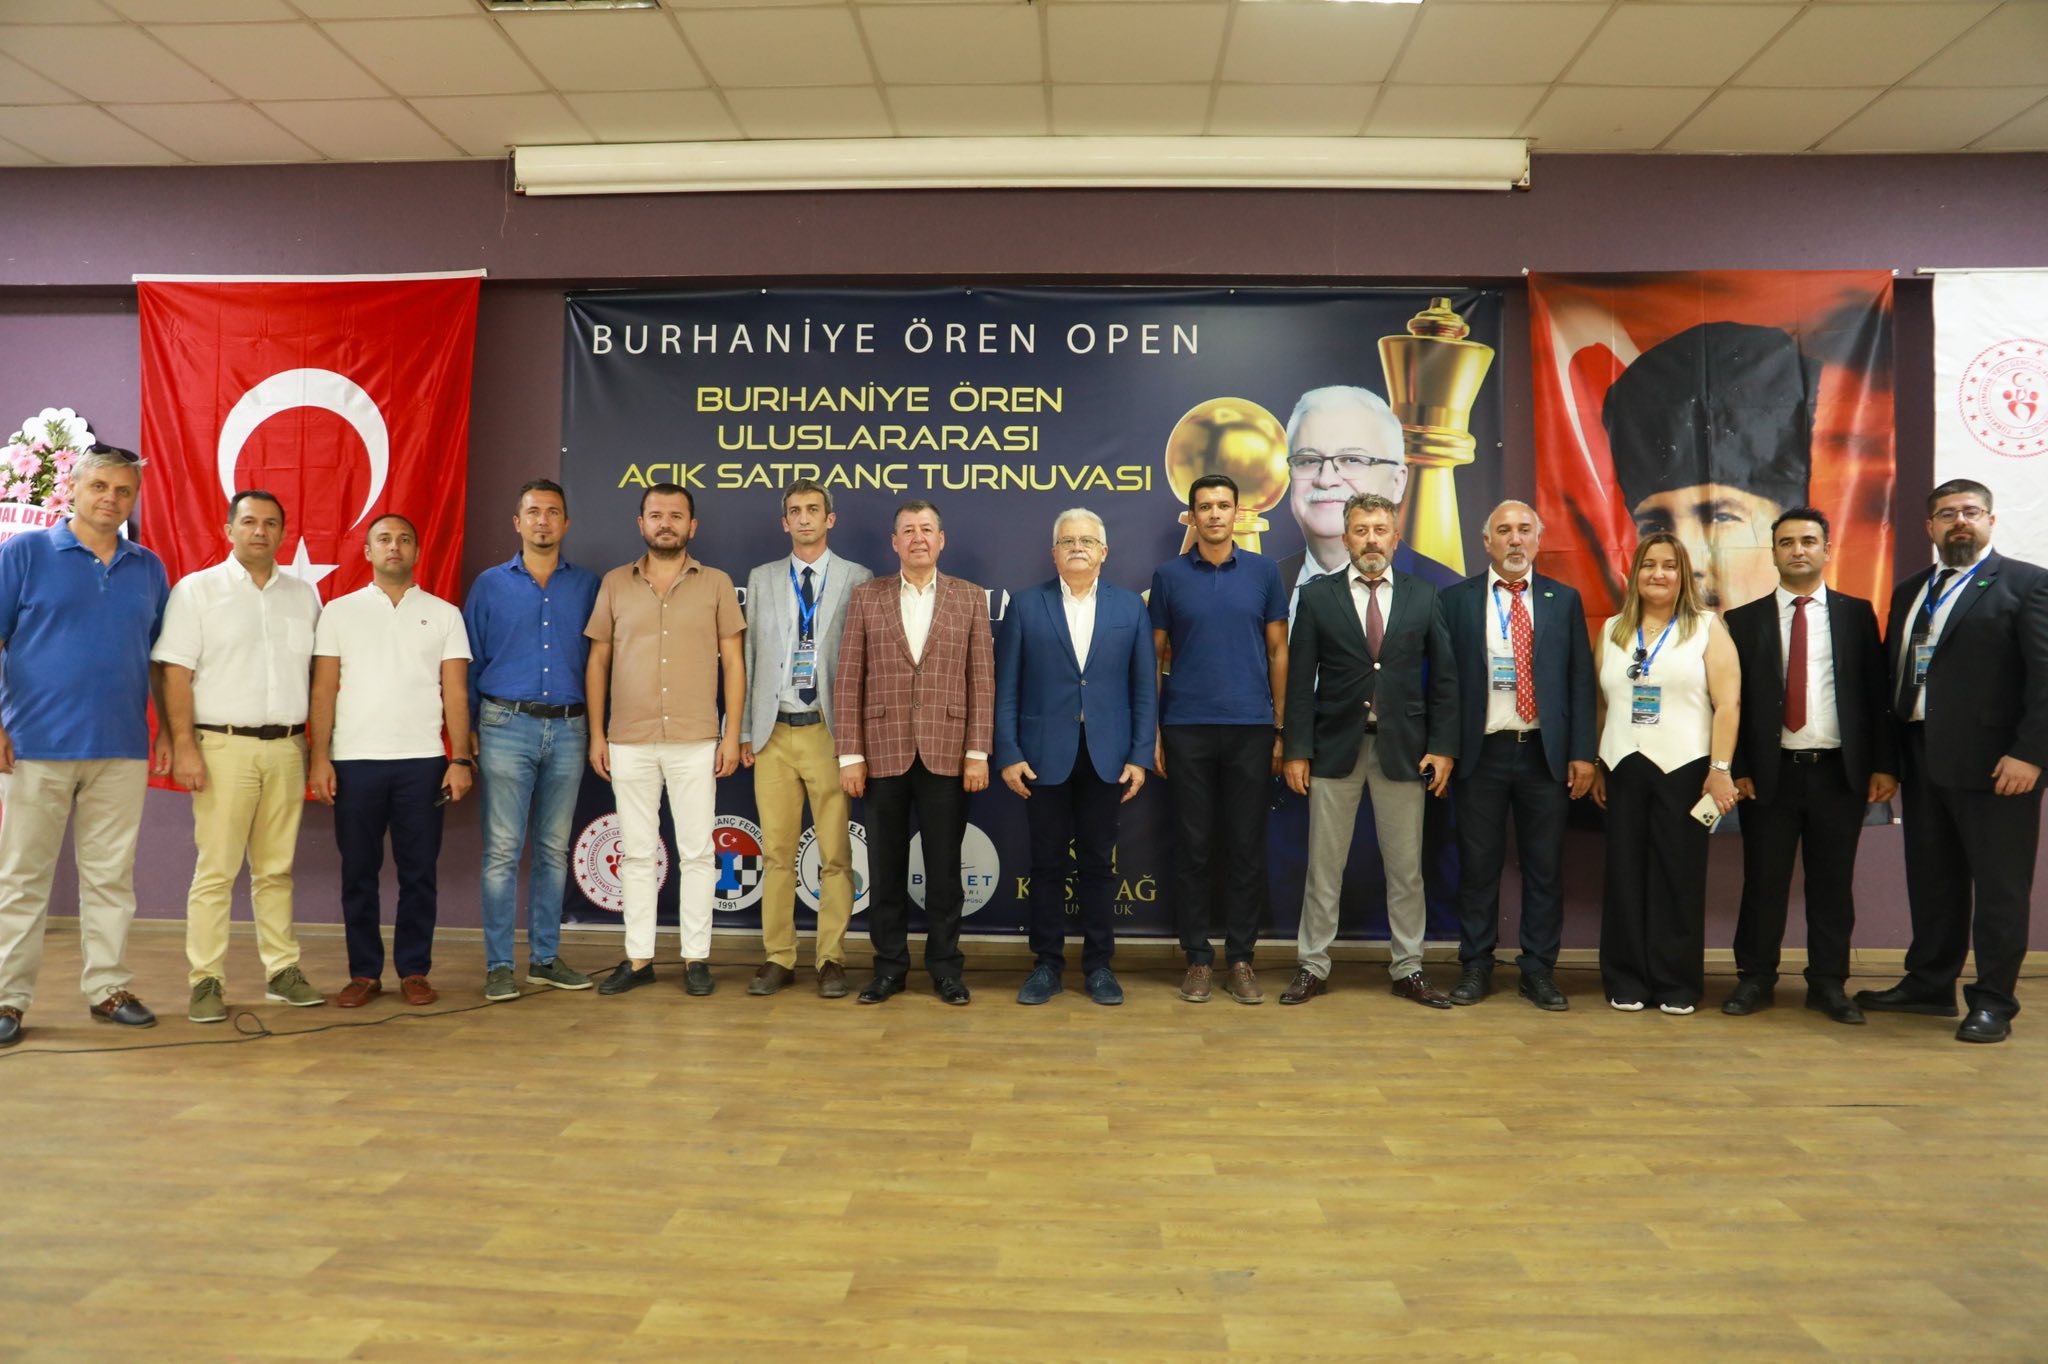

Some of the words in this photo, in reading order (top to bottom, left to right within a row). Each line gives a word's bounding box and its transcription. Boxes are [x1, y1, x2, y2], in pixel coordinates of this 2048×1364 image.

[592, 318, 876, 355] BURHANİYE
[903, 317, 1036, 354] ÖREN
[1066, 323, 1199, 355] OPEN
[696, 382, 930, 412] BURHANİYE
[949, 382, 1063, 413] ÖREN
[717, 425, 1040, 451] ULUSLARARASI
[918, 463, 1152, 491] TURNUVASI
[0, 507, 17, 523] AL
[21, 508, 64, 528] DEV
[718, 901, 737, 909] 1991
